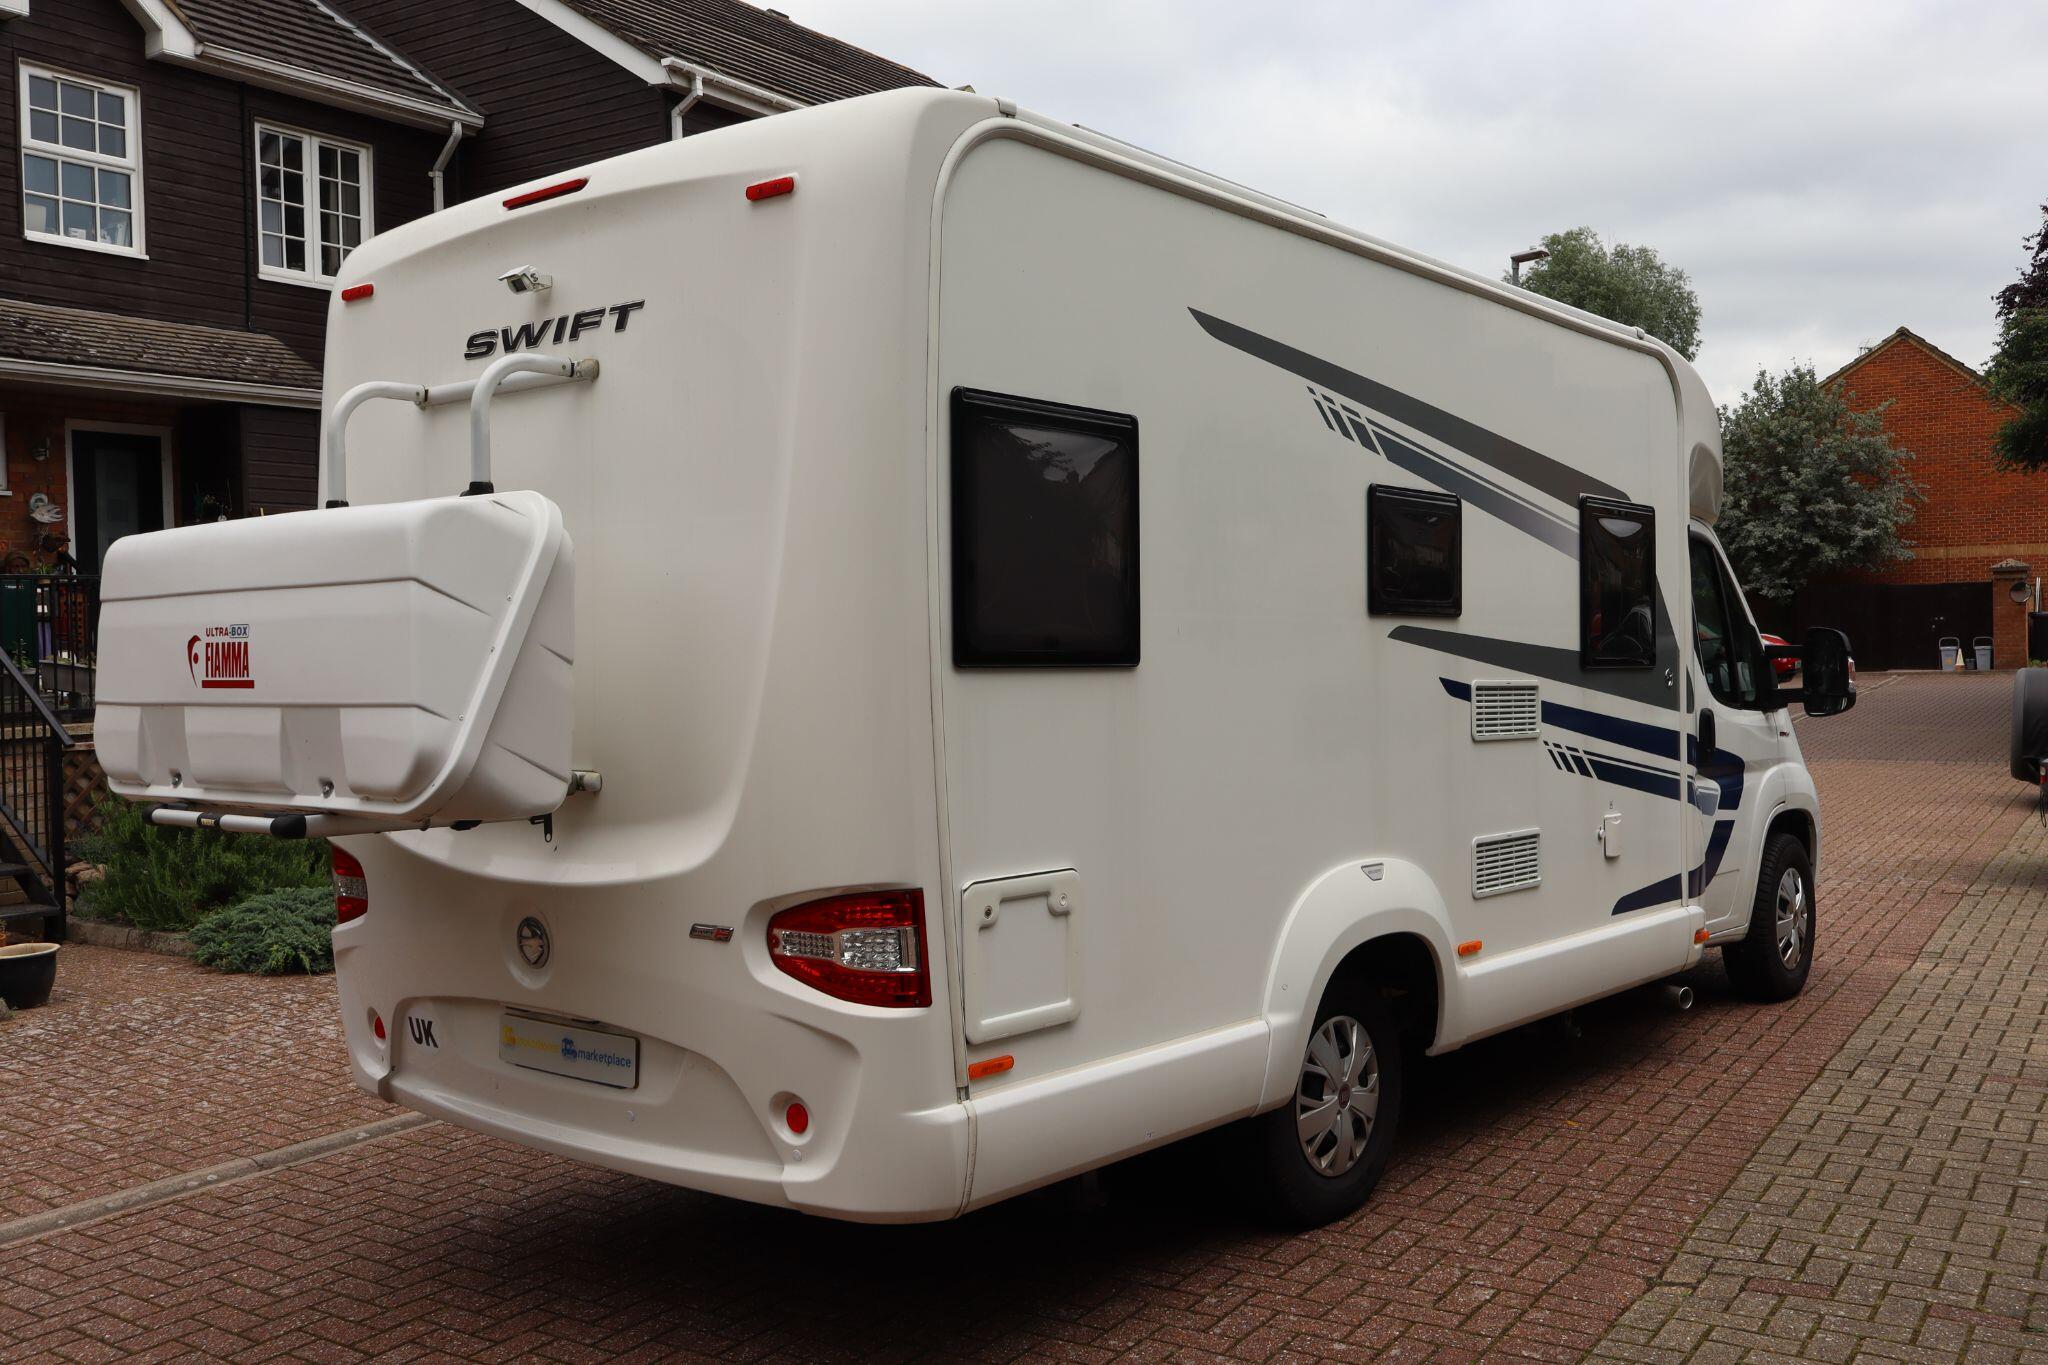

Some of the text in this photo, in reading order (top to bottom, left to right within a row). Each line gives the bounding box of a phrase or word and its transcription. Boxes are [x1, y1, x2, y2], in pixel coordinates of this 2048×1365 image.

[464, 299, 646, 360] SWIFT
[205, 626, 248, 637] ULTRA-BOX
[205, 641, 250, 678] FIAMMA
[408, 1016, 439, 1048] UK
[577, 1048, 632, 1068] marketplace
